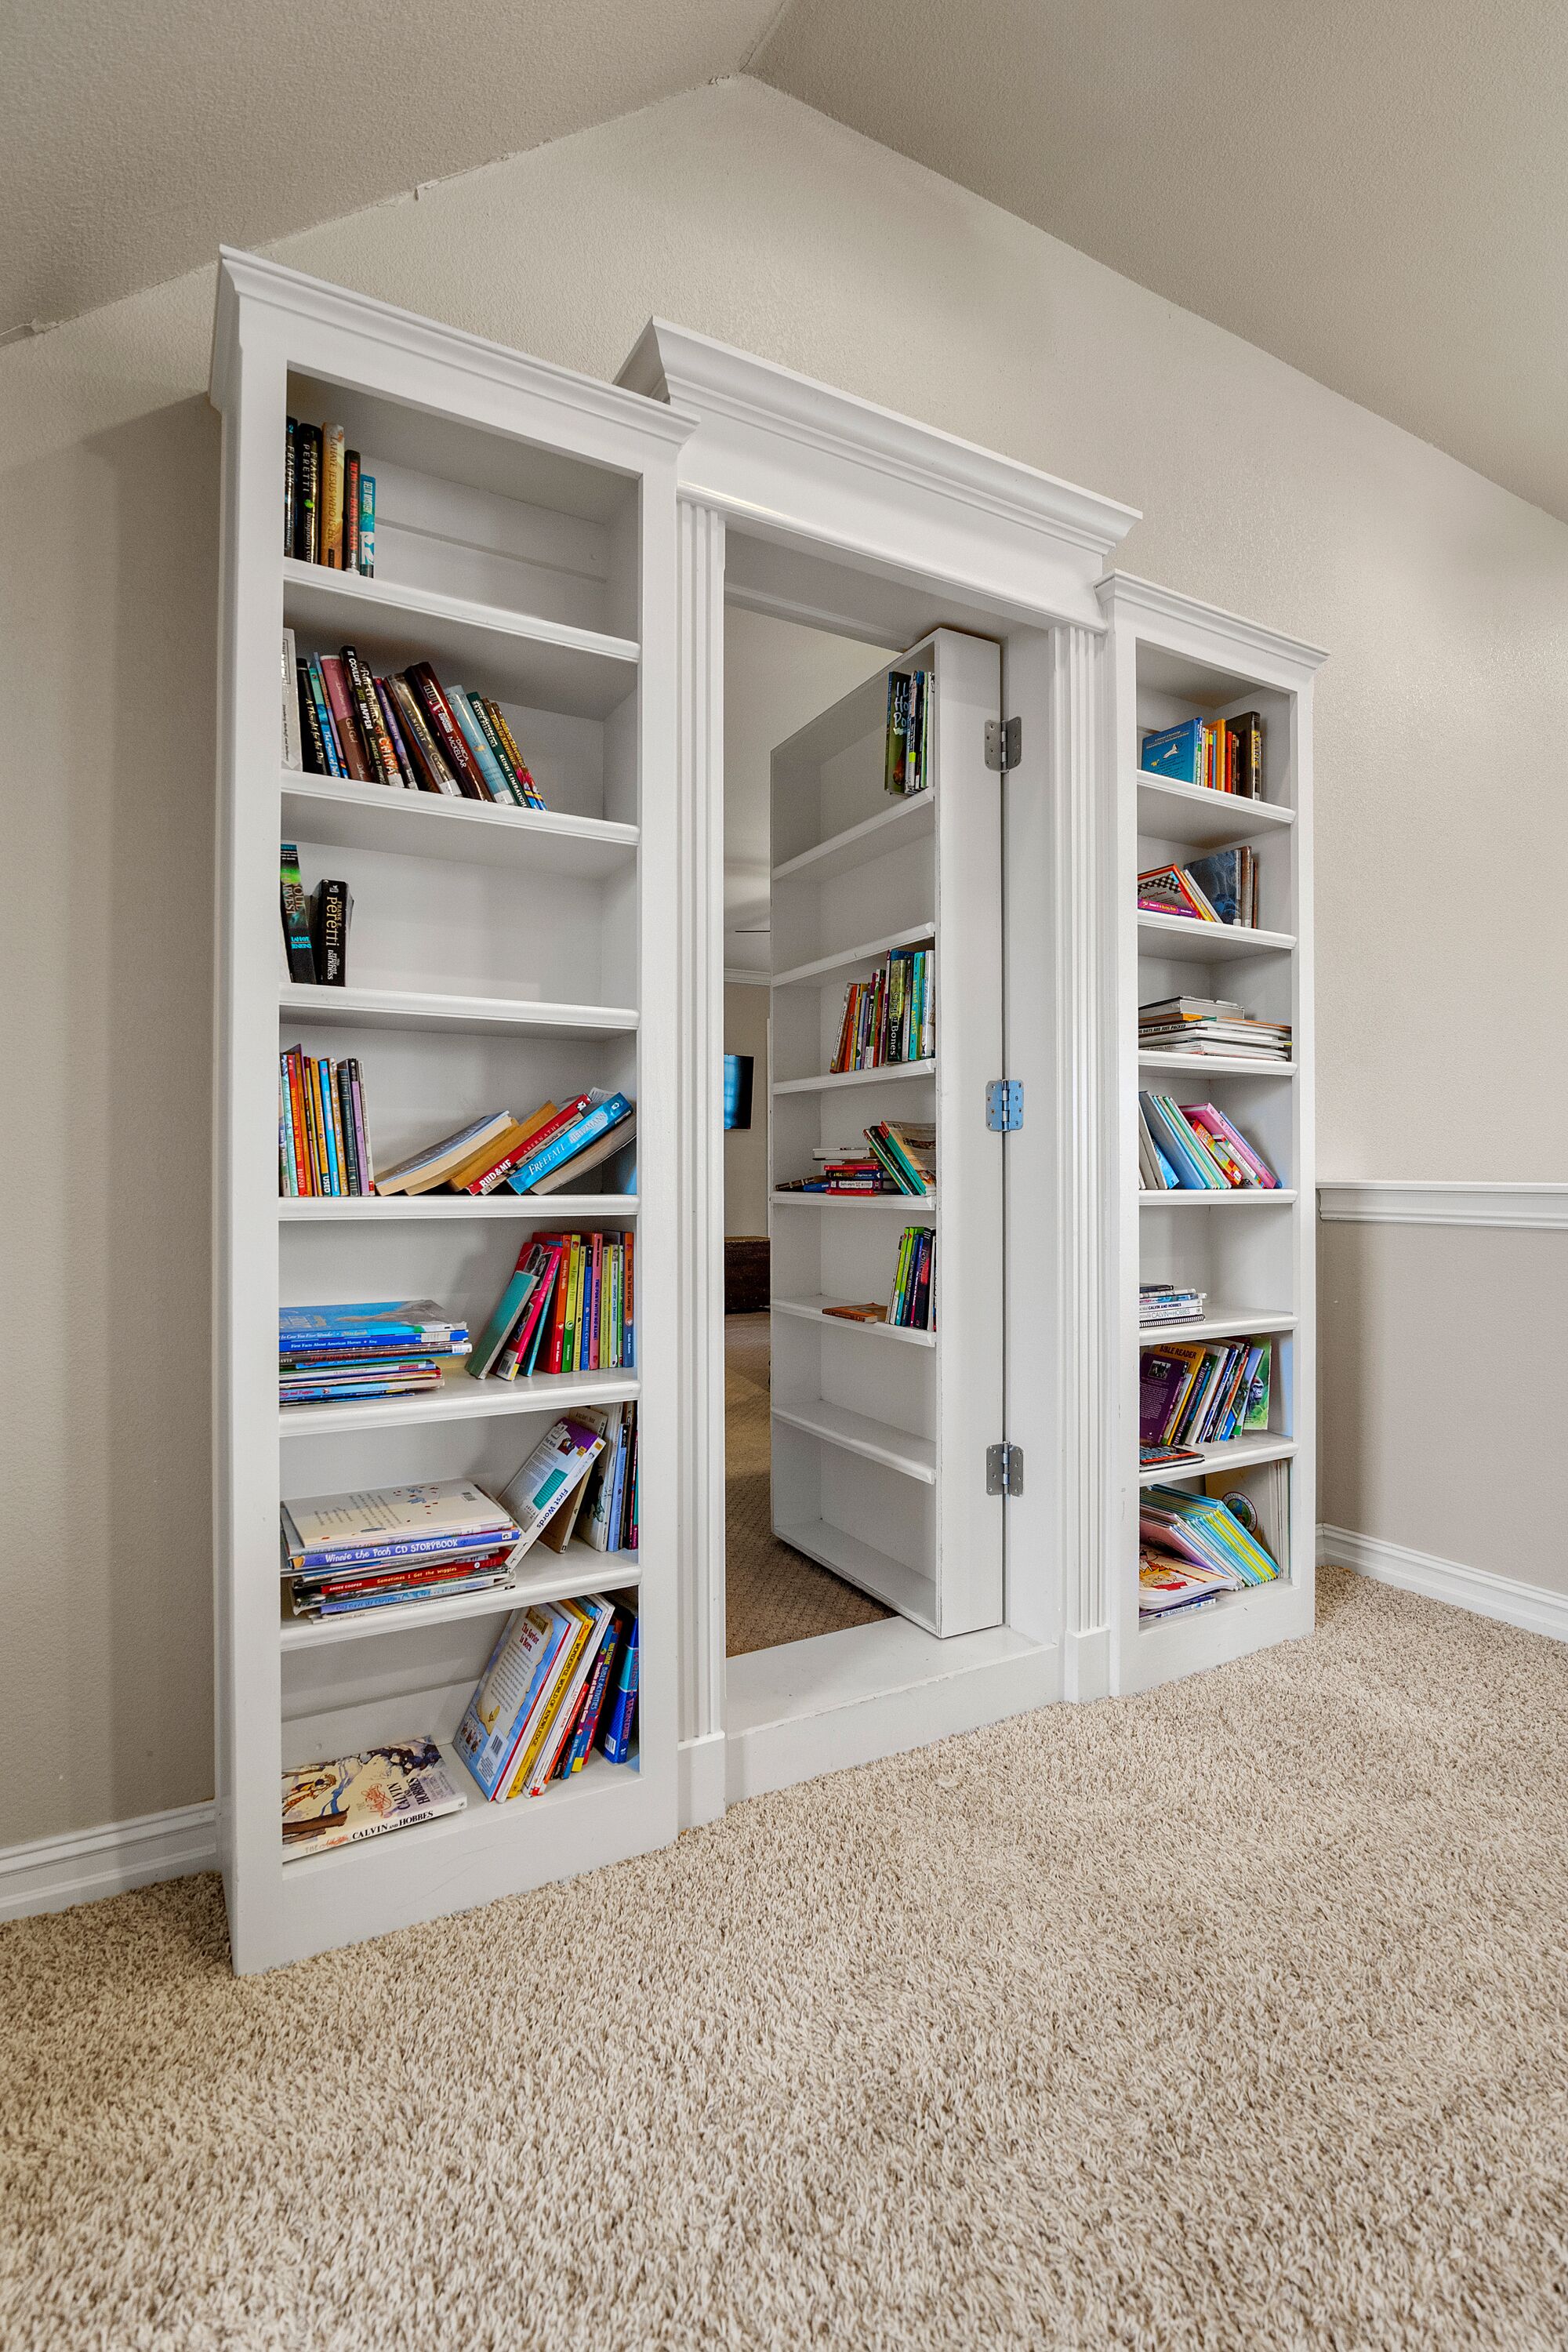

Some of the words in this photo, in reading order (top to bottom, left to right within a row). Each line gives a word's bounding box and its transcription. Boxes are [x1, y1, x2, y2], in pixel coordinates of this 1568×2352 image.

[328, 470, 337, 493] JESUS
[328, 495, 337, 517] WHO
[357, 688, 365, 700] JUST
[360, 703, 372, 729] HAPPEN
[412, 718, 426, 742] NIGHT
[379, 737, 394, 775] CHINA
[456, 739, 469, 762] DANICA
[499, 754, 510, 772] RUSH
[506, 774, 528, 808] LIMBAUGH
[294, 883, 306, 911] SOUL
[890, 1025, 898, 1055] Bones
[523, 1122, 560, 1153] ABERNATHY
[528, 1143, 565, 1175] FREEFALL
[1159, 1345, 1175, 1354] BIBLE
[1176, 1348, 1197, 1359] READER
[554, 1488, 568, 1506] First
[536, 1505, 557, 1529] Words
[325, 1552, 352, 1563] Winnie
[354, 1550, 370, 1559] the
[372, 1546, 392, 1557] Pooh
[395, 1545, 408, 1554] CD
[411, 1539, 458, 1552] STORYBOOK
[377, 1575, 405, 1584] Sometimes
[523, 1639, 532, 1652] Born
[528, 1629, 539, 1644] Savior
[562, 1642, 581, 1677] WONDERFUL
[598, 1667, 608, 1682] BIBLE
[552, 1679, 566, 1700] WORLD
[549, 1699, 556, 1708] OF
[532, 1709, 552, 1748] KNOWLEDGE
[622, 1697, 635, 1740] WONDER
[387, 1782, 412, 1811] CALVIN
[406, 1777, 430, 1806] HOBBES
[352, 1824, 389, 1840] CALVIN
[399, 1810, 434, 1827] HOBBES
